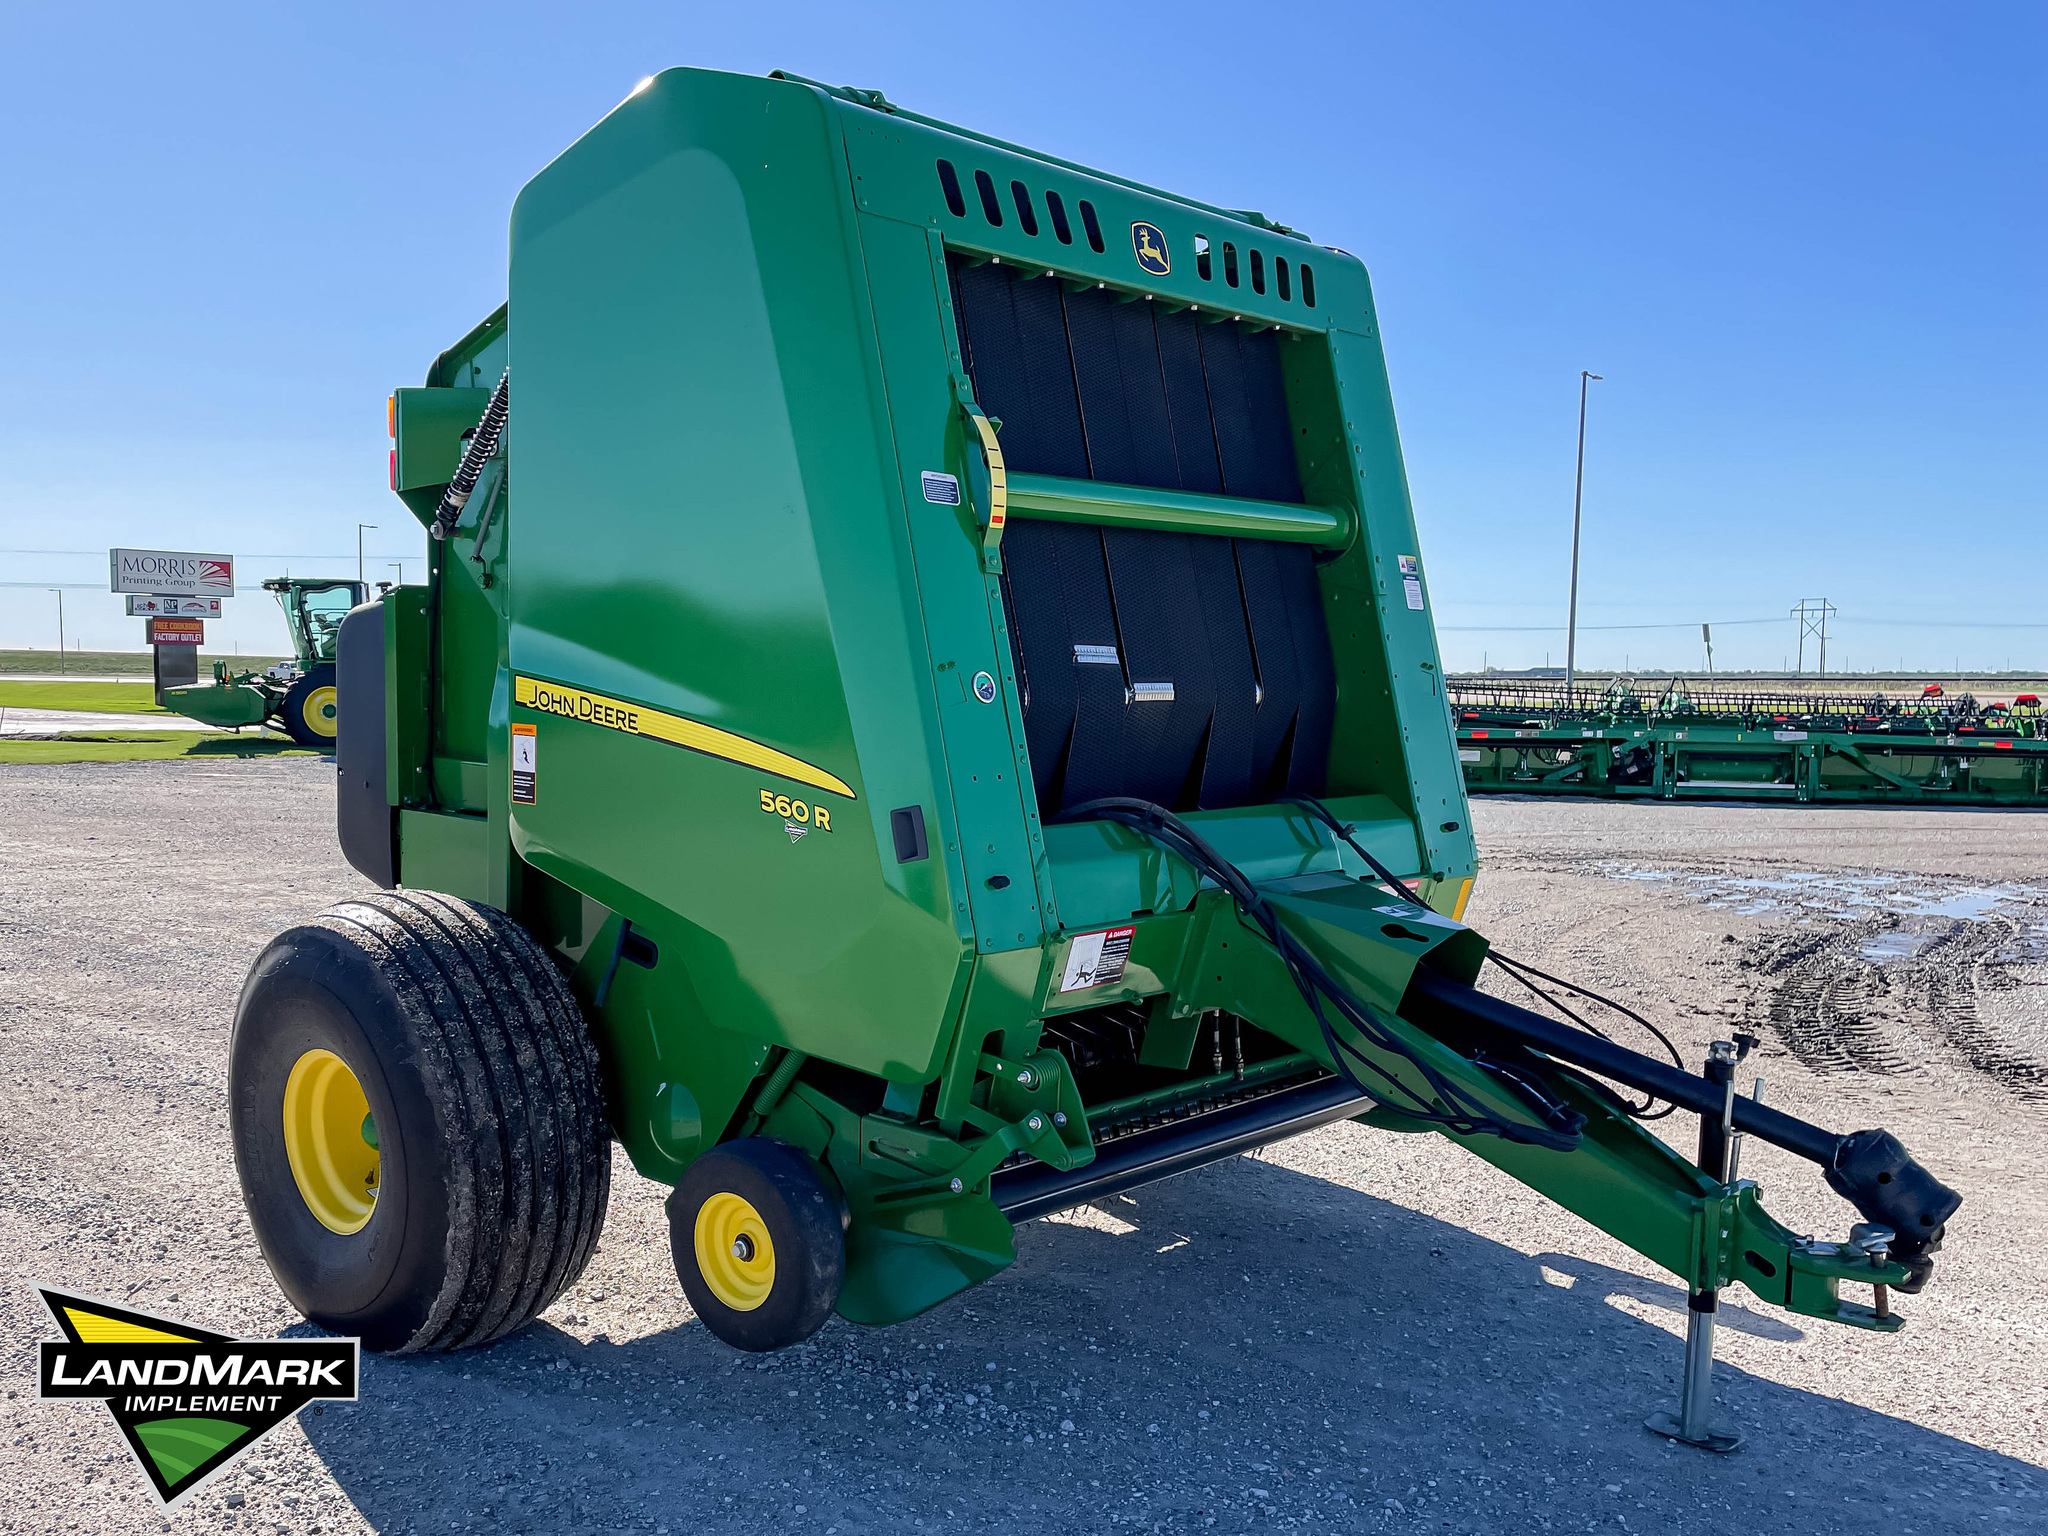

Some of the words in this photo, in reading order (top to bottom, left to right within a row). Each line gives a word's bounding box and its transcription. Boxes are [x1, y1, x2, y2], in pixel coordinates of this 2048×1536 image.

[123, 556, 196, 578] MORRIS
[123, 575, 163, 586] Printing
[165, 578, 196, 588] Group
[154, 621, 169, 630] FREE
[154, 632, 179, 641] FACTORY
[180, 633, 202, 642] OUTLET
[528, 685, 575, 715] JOHN
[579, 695, 638, 731] DEERE
[759, 788, 810, 824] 560
[813, 804, 833, 833] R
